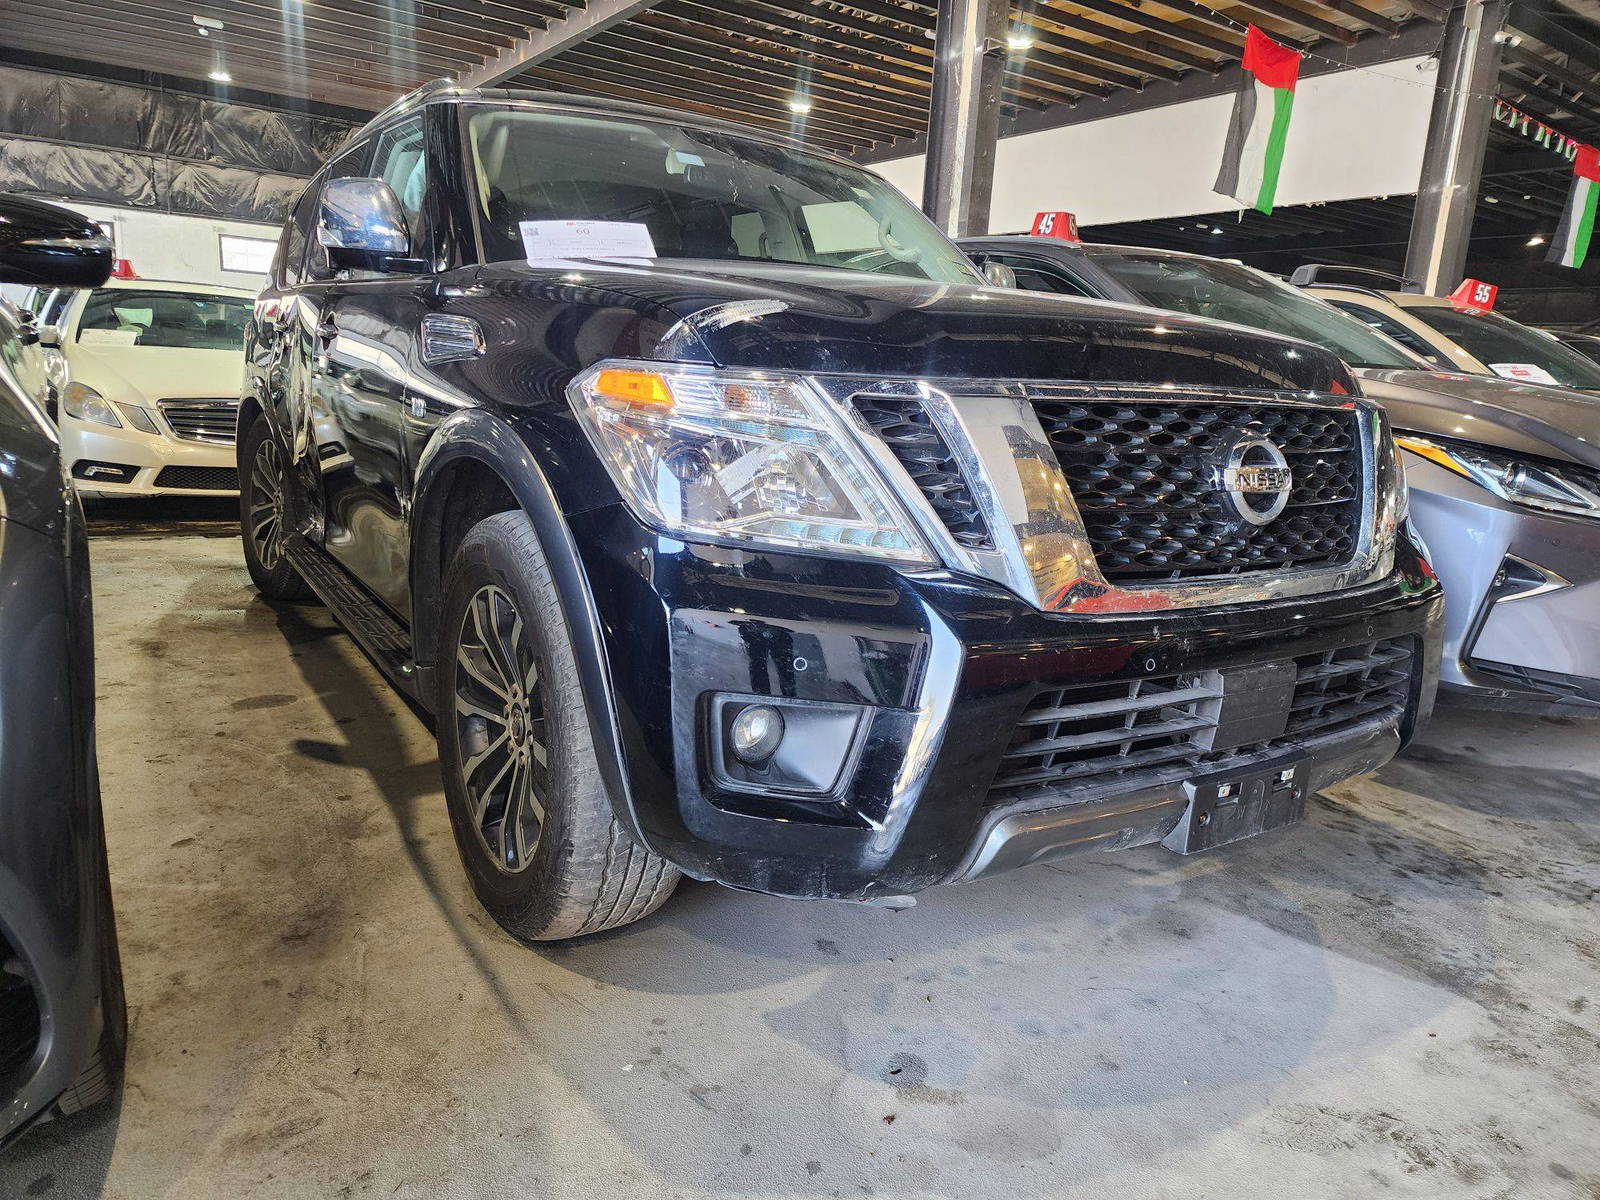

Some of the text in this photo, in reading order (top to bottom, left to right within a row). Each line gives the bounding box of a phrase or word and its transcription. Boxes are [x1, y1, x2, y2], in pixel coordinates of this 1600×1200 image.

[1039, 213, 1056, 234] 45
[1475, 284, 1491, 303] 55
[1239, 471, 1290, 487] NISSAN
